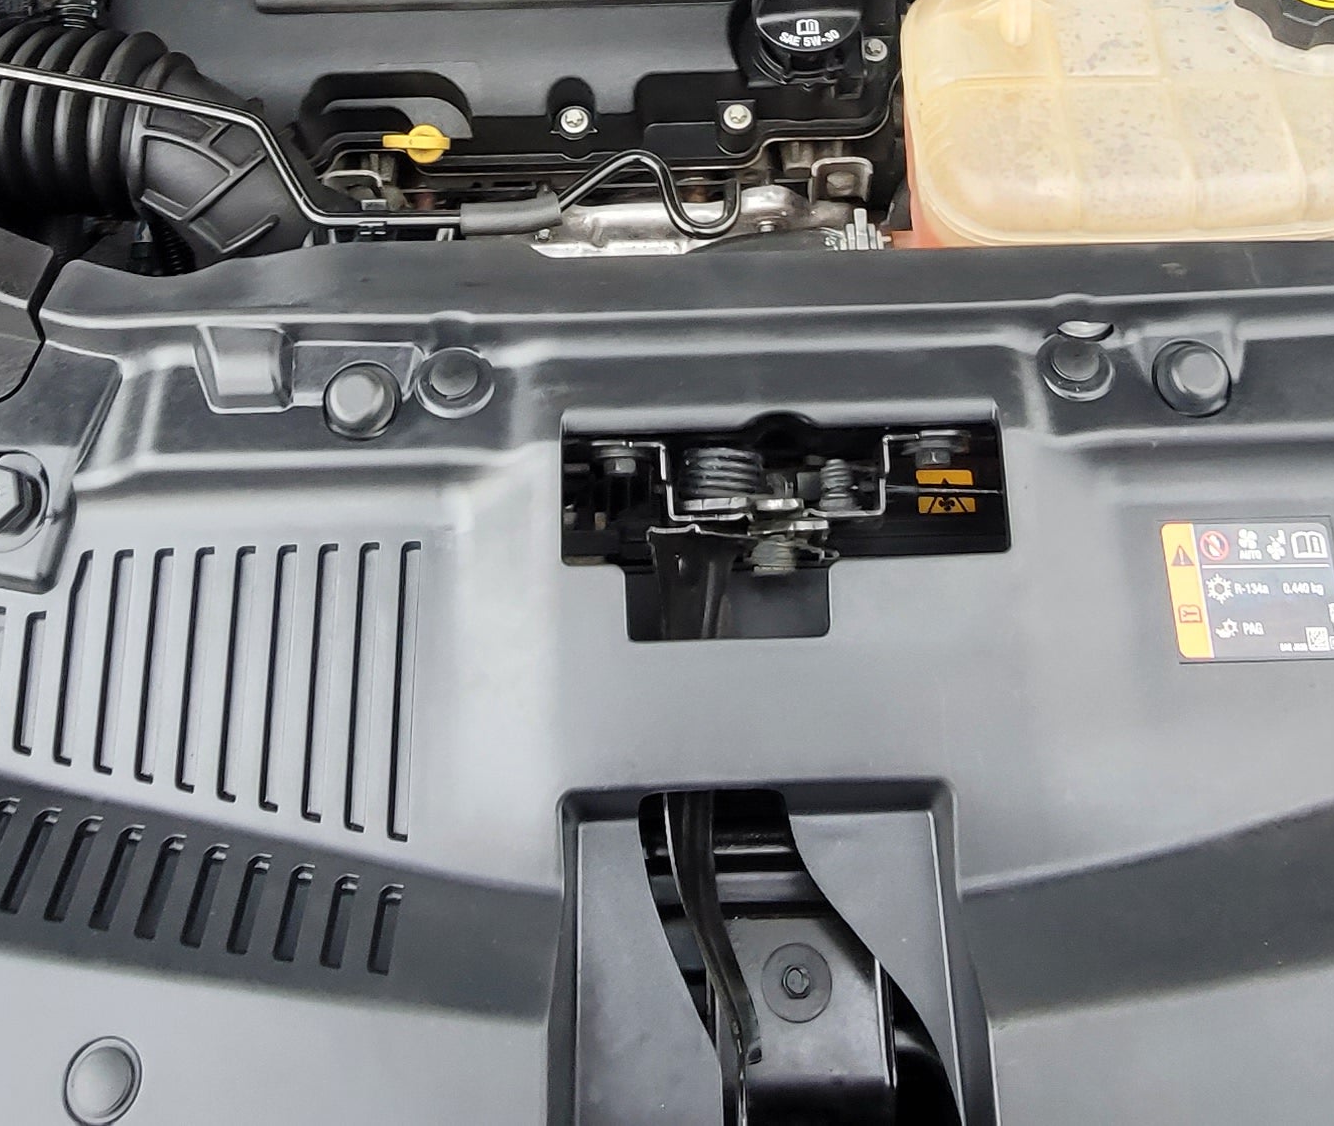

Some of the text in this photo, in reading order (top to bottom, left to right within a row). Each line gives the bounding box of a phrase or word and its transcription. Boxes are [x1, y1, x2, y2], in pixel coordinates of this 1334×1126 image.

[779, 29, 841, 48] SAE 5W-30
[1239, 549, 1262, 560] AUTO
[1234, 582, 1270, 595] R-134a
[1243, 621, 1265, 636] PAG
